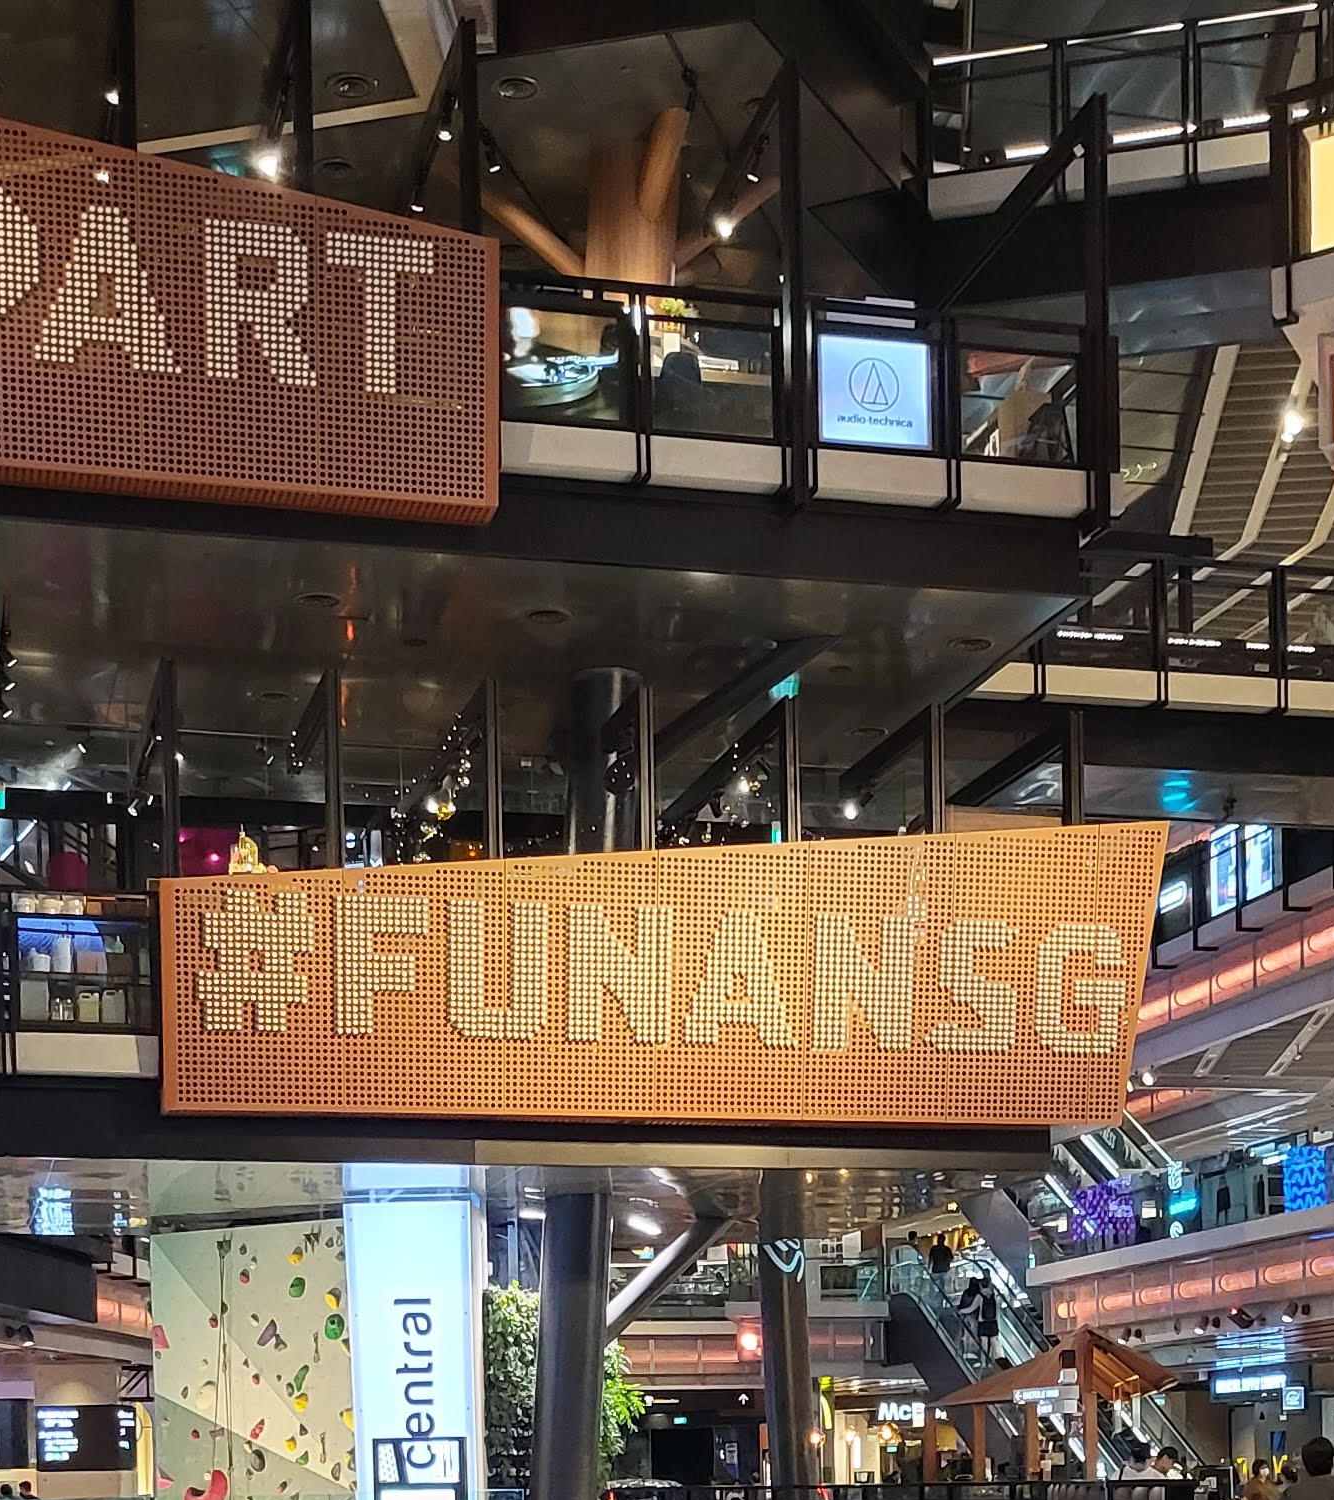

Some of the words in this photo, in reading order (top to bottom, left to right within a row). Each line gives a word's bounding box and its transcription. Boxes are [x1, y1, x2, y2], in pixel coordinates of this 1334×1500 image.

[33, 205, 436, 396] ART
[836, 413, 914, 429] audio-technica
[195, 888, 1128, 1053] #FUNANSG
[393, 1296, 435, 1469] central
